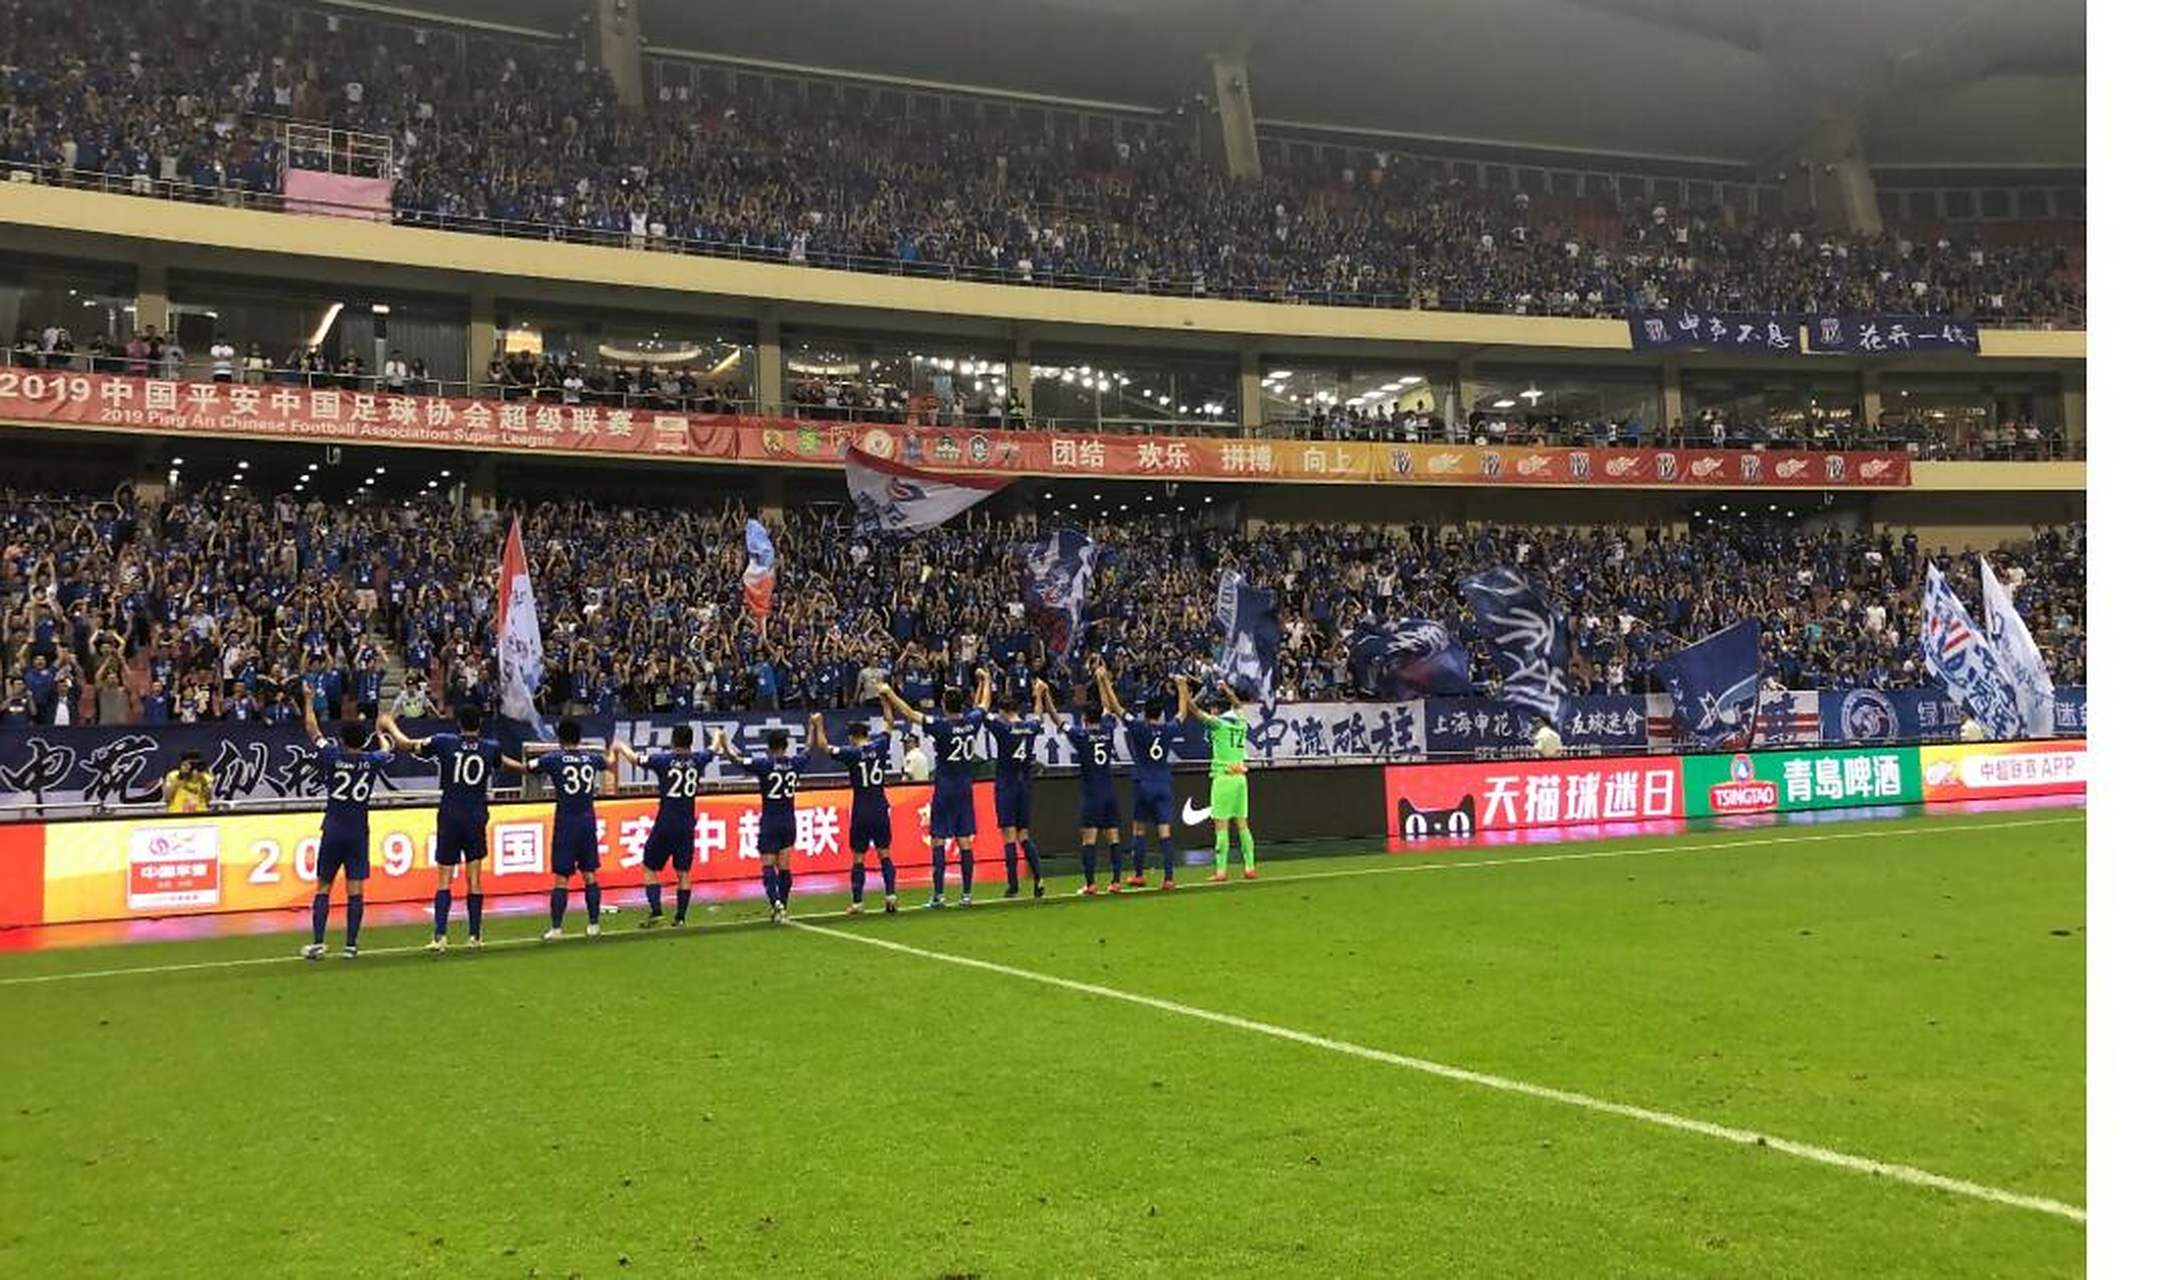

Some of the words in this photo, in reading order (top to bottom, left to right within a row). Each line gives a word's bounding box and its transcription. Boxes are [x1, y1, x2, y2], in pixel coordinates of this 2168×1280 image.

[101, 407, 143, 423] 2019
[148, 411, 187, 428] Ping
[192, 415, 215, 428] An
[220, 416, 286, 432] Chinese
[291, 421, 355, 435] Football
[360, 422, 449, 441] Association
[454, 427, 499, 443] Super
[502, 432, 555, 448] League
[1051, 438, 1105, 469] 团结
[1136, 441, 1190, 470] 欢乐
[1302, 446, 1354, 473] 向上
[947, 735, 975, 761] 20
[1012, 738, 1027, 762] 4
[1094, 743, 1107, 765] 5
[1150, 737, 1163, 760] 6
[453, 751, 484, 785] 10
[562, 764, 594, 795] 39
[666, 768, 698, 798] 28
[859, 759, 884, 788] 16
[1783, 755, 1901, 802] 青岛啤酒
[331, 771, 370, 801] 26
[767, 771, 799, 800] 23
[1482, 769, 1675, 826] 天猫球迷日
[1713, 786, 1775, 807] TSINGTAO
